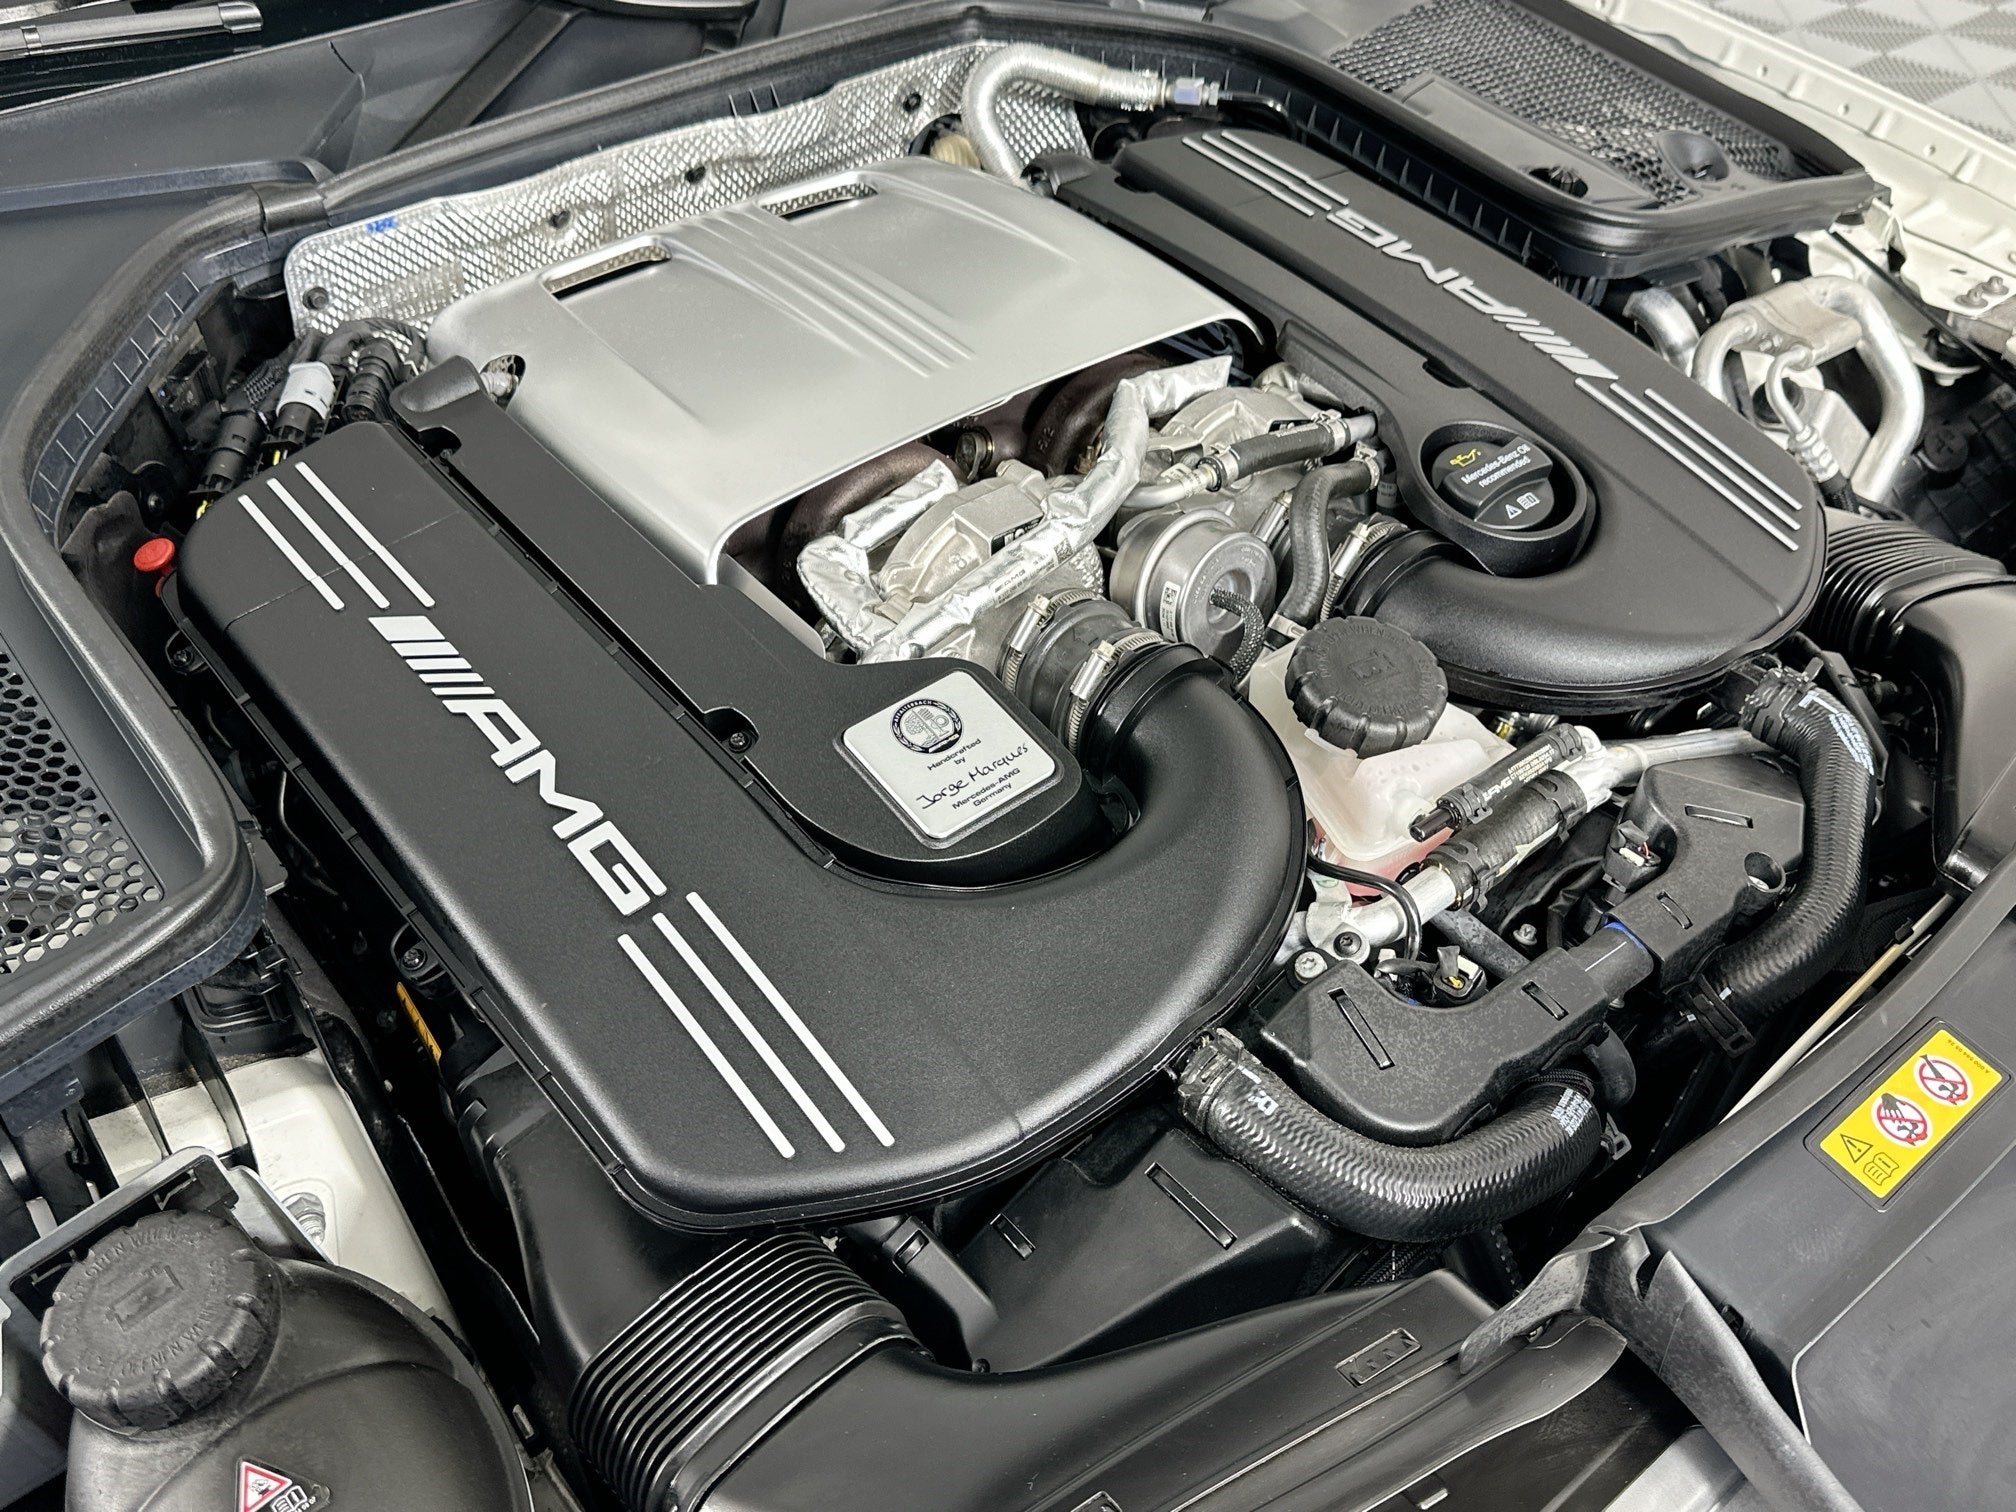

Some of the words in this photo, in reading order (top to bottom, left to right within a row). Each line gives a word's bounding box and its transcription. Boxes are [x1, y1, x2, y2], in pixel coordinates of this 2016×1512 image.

[1461, 450, 1520, 485] Mercedes-Benz
[1517, 443, 1531, 455] Oil
[1478, 455, 1532, 488] recommended
[927, 738, 982, 771] Handcrafted
[954, 756, 966, 766] by
[916, 779, 970, 810] Jorge
[968, 742, 1029, 782] Marques
[952, 767, 1021, 809] Mercedes-AMG
[973, 782, 1013, 807] Germany
[441, 698, 668, 916] AMG
